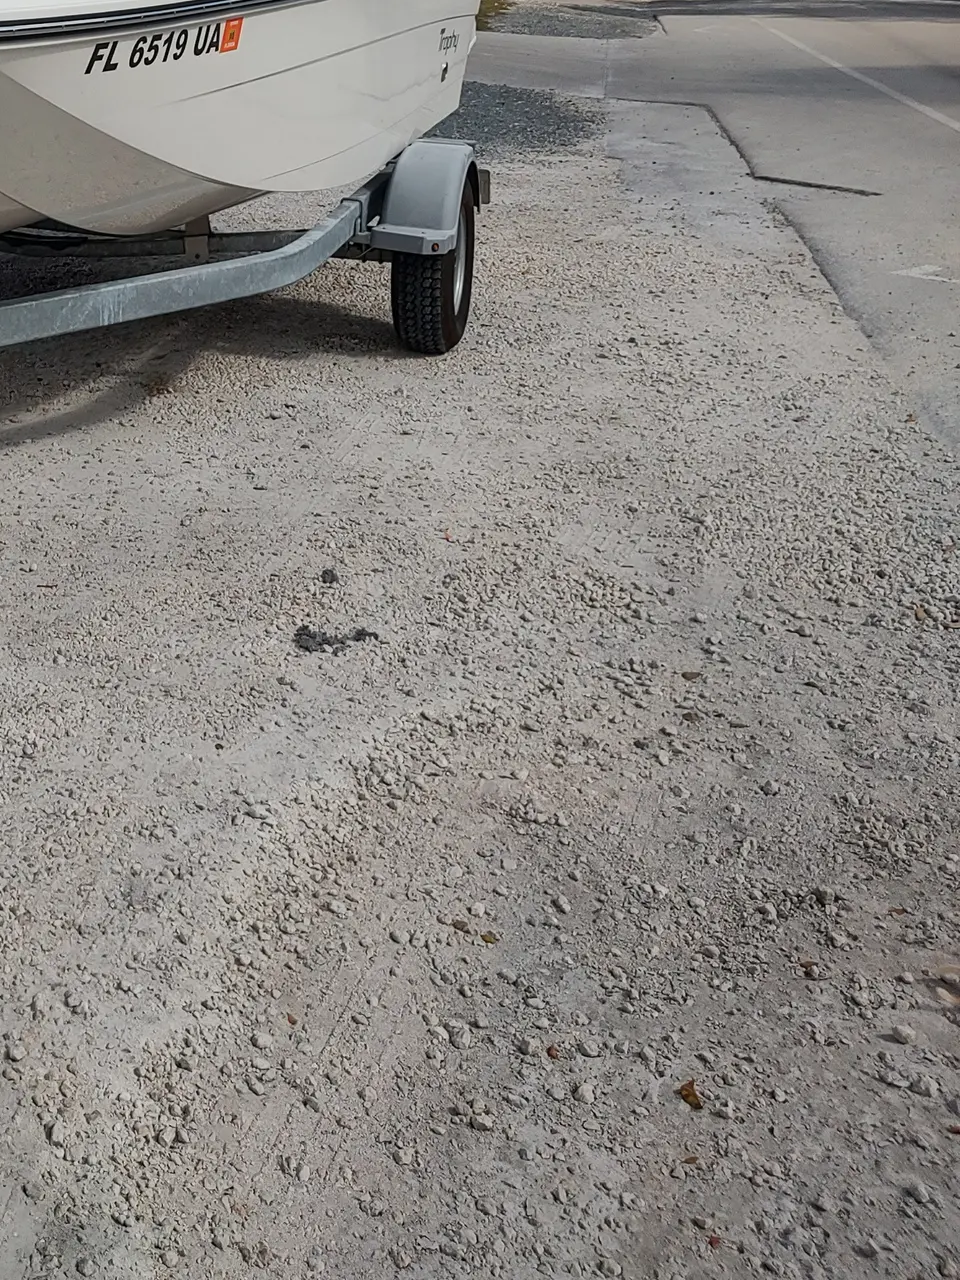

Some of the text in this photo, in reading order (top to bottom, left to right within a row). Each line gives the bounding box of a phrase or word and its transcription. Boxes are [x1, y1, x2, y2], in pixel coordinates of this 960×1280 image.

[84, 22, 222, 75] FL 6519 UA
[438, 27, 460, 56] Trophy
